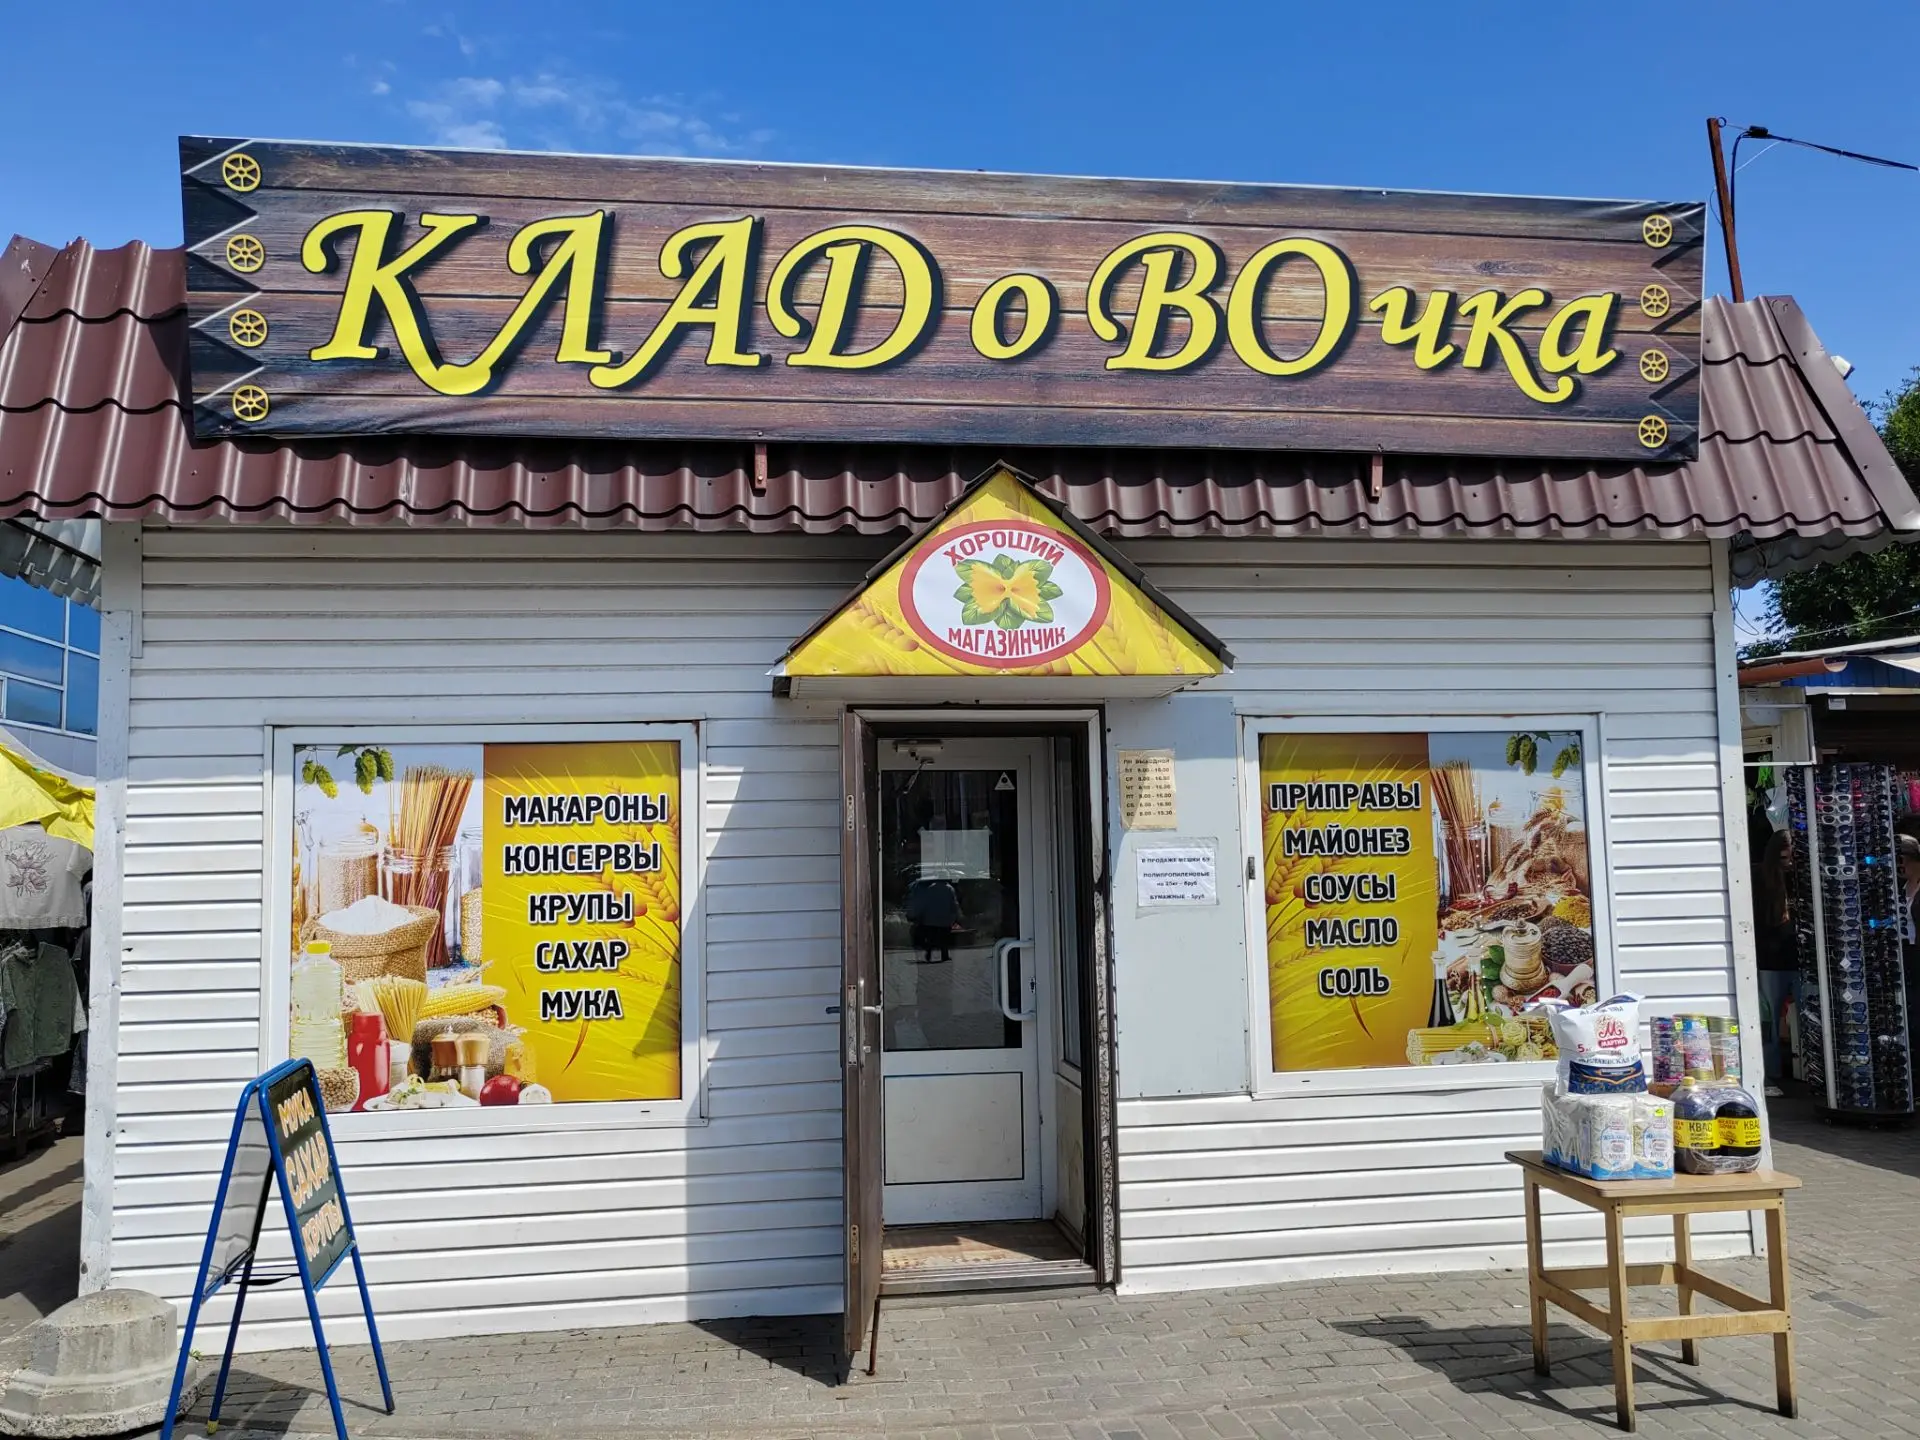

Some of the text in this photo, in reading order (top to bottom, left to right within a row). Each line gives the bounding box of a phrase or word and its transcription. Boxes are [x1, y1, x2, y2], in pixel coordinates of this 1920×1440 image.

[942, 530, 1065, 567] ХОРОШИЙ
[947, 626, 1066, 657] МАГАЗИНЧИК
[504, 794, 669, 825] МАКАРОНЫ
[1270, 781, 1422, 811] ПРИПРАВЫ
[1284, 824, 1411, 855] МАЙОНЕЗ
[504, 843, 662, 874] КОНСЕРВЫ
[1305, 873, 1396, 902] СОУСЫ
[529, 892, 634, 924] КРУПЫ
[1306, 918, 1398, 946] МАСЛО
[535, 940, 629, 971] САХАР
[1319, 967, 1391, 996] СОЛЬ
[540, 988, 622, 1020] МУКА
[277, 1086, 315, 1139] МУКА
[1689, 1122, 1713, 1133] КВАС
[285, 1130, 330, 1210] САХАР
[301, 1192, 345, 1263] КРУПЫ
